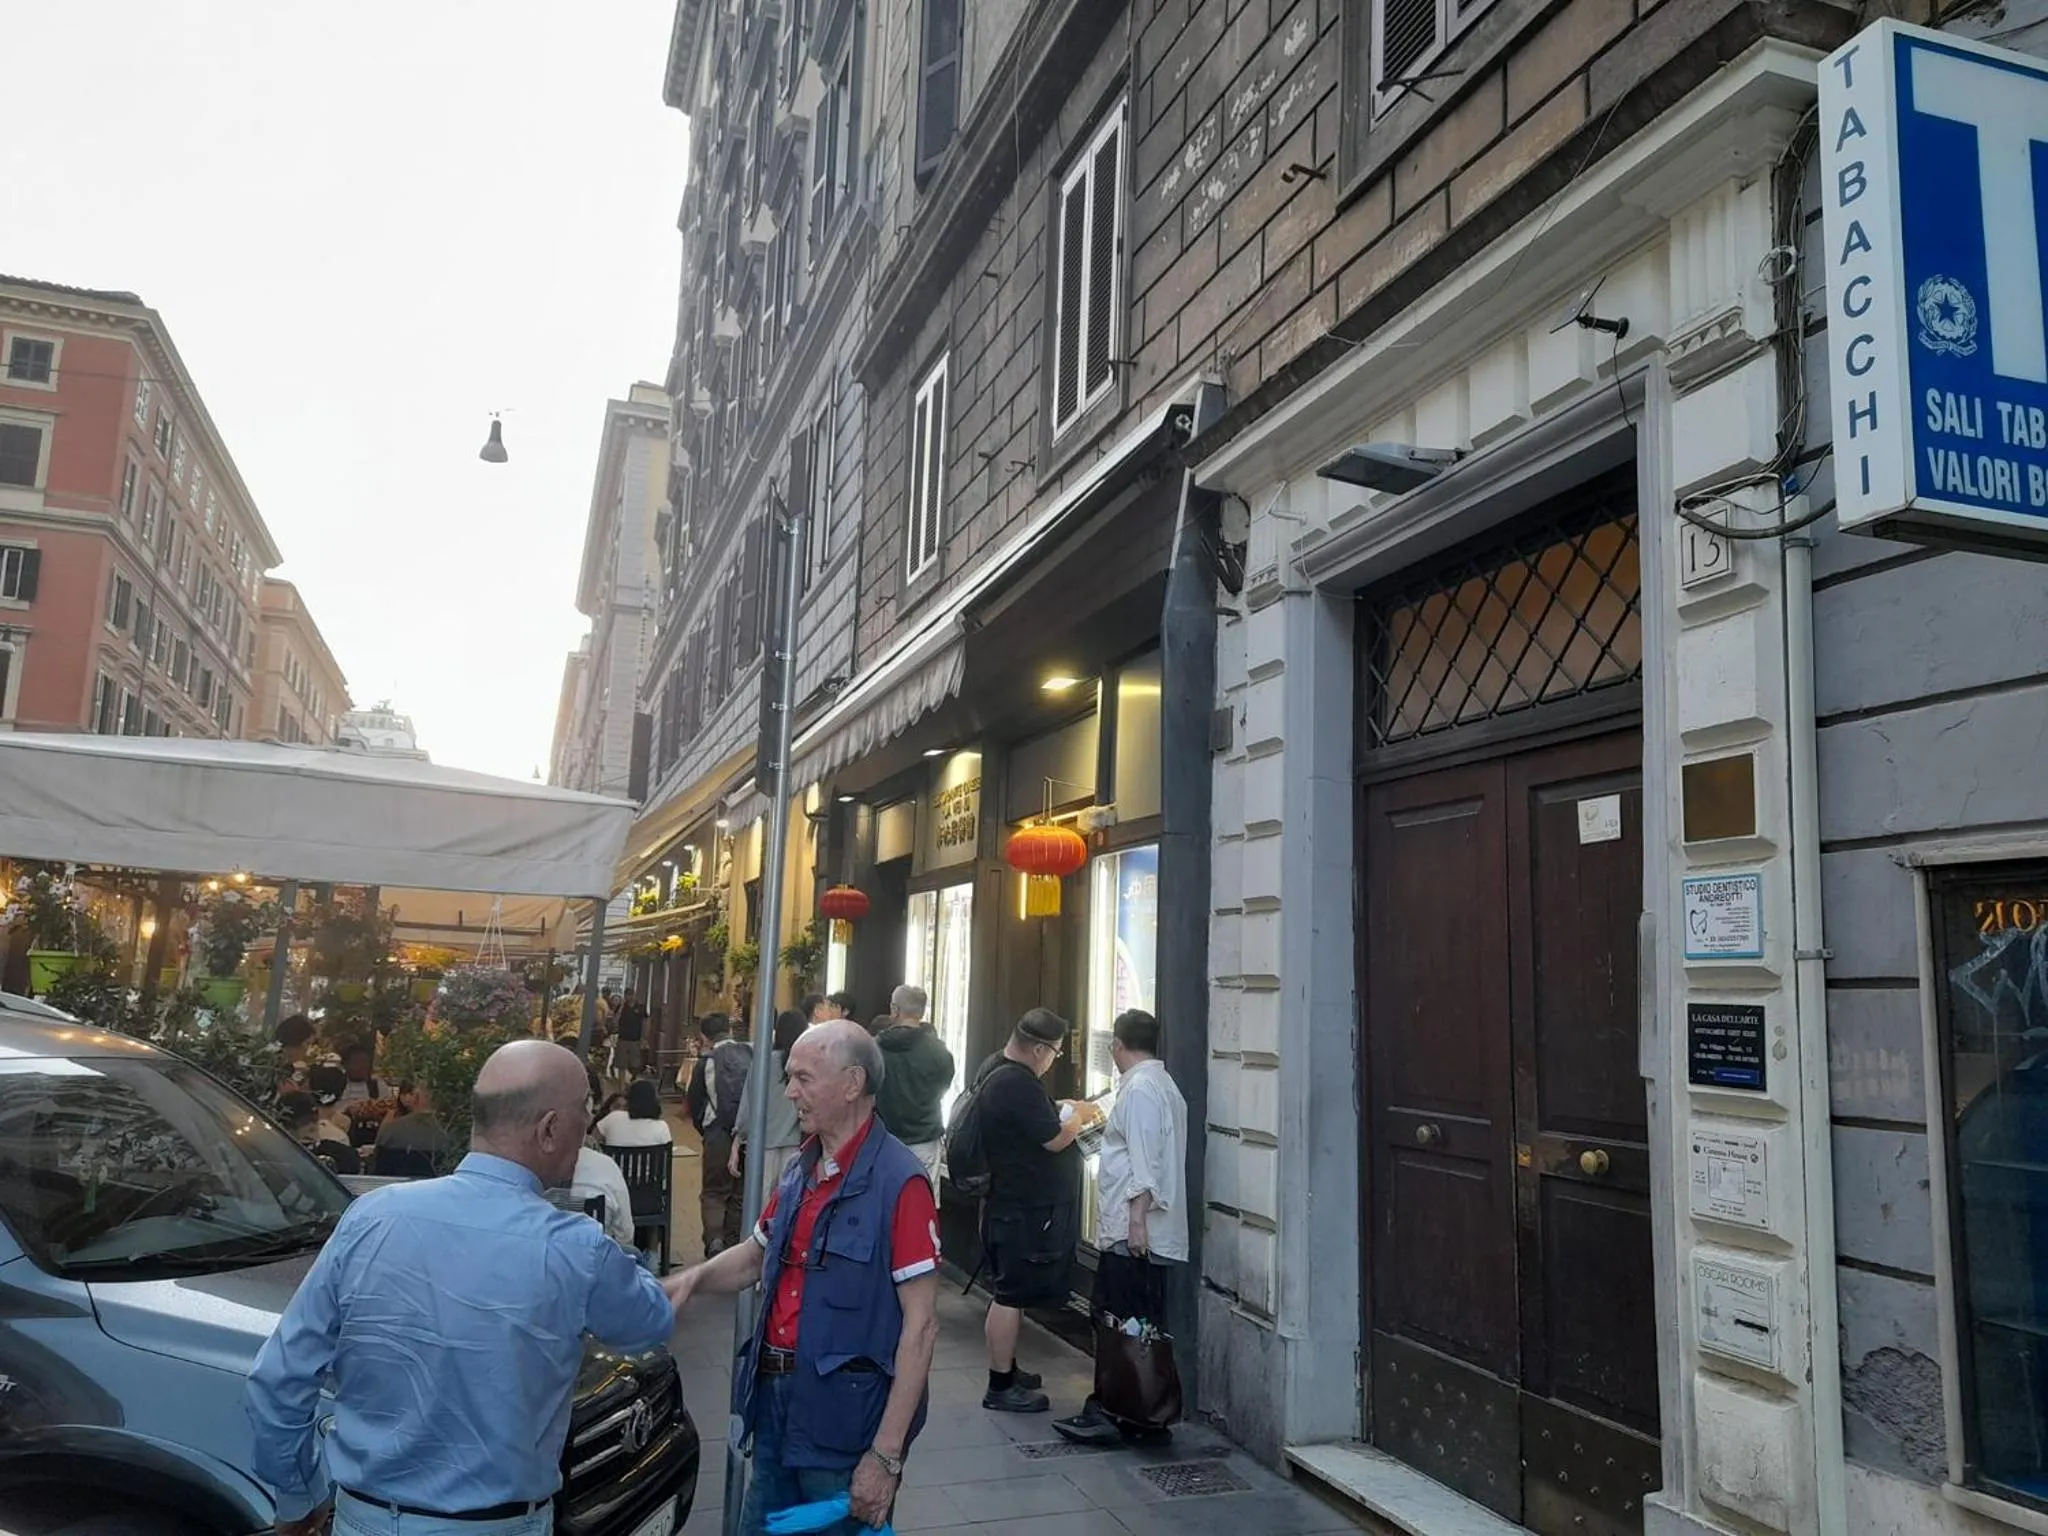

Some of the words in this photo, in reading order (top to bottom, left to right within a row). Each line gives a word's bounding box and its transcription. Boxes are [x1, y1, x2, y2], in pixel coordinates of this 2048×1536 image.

[1833, 45, 1879, 496] TABACCHI
[1926, 387, 1984, 439] SALI
[1926, 446, 2021, 503] VALORI
[2027, 463, 2048, 507] B
[1685, 883, 1711, 896] STUDIO
[1713, 879, 1757, 894] DENTISTICO
[1699, 892, 1744, 903] ANDREOTTI
[1692, 1013, 1702, 1023] LA
[1702, 1014, 1720, 1023] CASA
